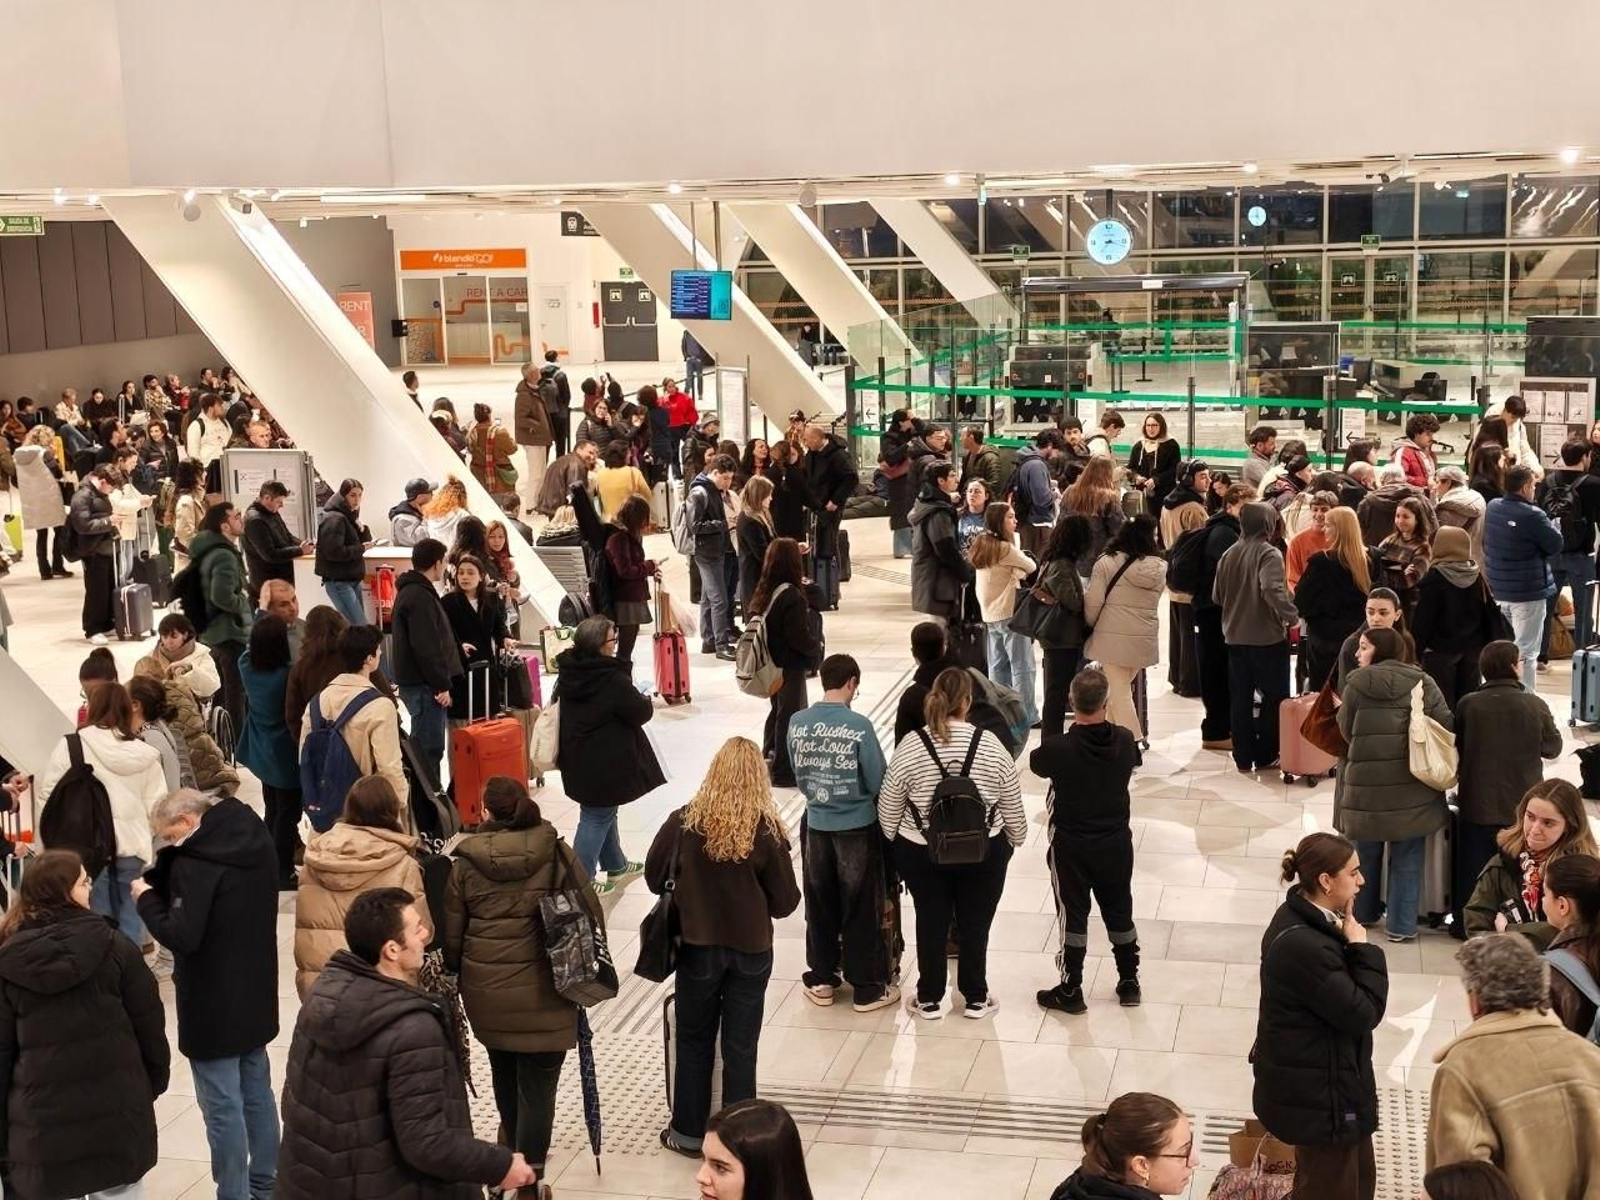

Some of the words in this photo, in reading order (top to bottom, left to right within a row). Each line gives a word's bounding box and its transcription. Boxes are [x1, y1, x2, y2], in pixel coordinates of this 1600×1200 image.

[339, 300, 370, 311] RENT
[811, 721, 866, 742] Rushed
[792, 738, 816, 752] Not
[818, 738, 855, 755] Loud
[834, 754, 858, 770] See
